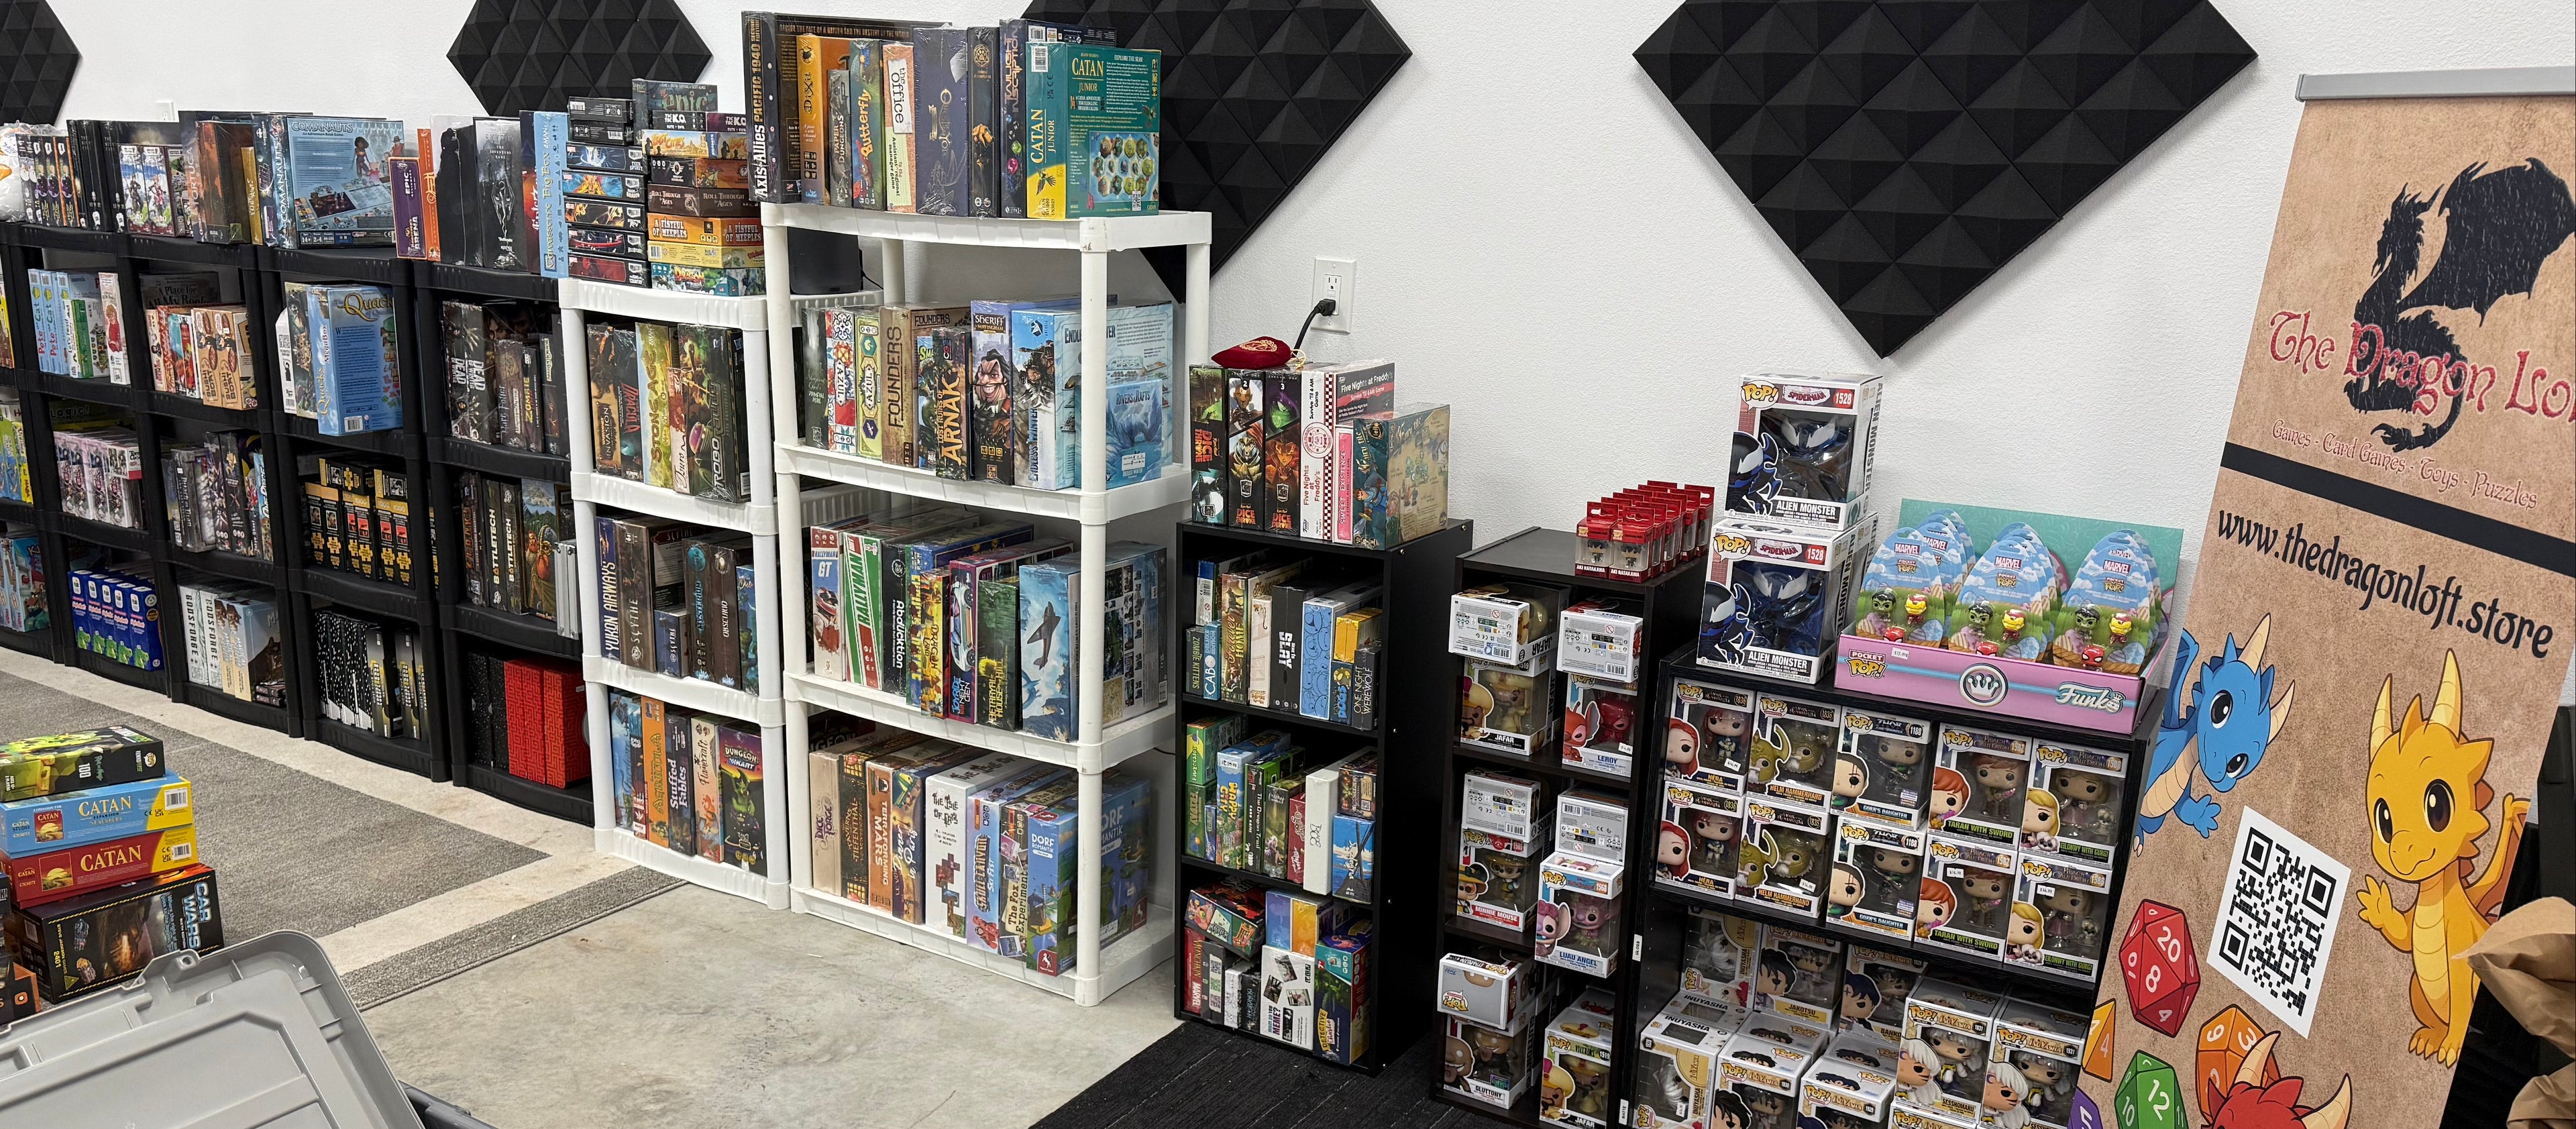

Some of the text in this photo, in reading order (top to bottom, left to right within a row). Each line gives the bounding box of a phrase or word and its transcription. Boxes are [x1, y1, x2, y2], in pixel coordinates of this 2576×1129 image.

[751, 44, 761, 72] 1940
[1071, 58, 1104, 76] CATAN
[751, 73, 763, 122] PACIFIC
[1078, 82, 1098, 93] JUNIOR
[291, 121, 354, 133] COMANAUTS
[859, 89, 873, 160] Butterfly
[1030, 109, 1045, 164] CATAN
[275, 140, 288, 229] COMANAUTS
[652, 227, 687, 238] OF MEEPLES
[726, 232, 761, 242] OF MEEPLES
[337, 292, 393, 321] Quack
[914, 313, 951, 325] FOUNDERS
[38, 330, 46, 354] Pete
[455, 358, 466, 384] DEAD
[473, 360, 486, 391] DEAD
[887, 326, 902, 428] FOUNDERS
[2269, 310, 2576, 424] The Dragon Lo
[202, 370, 211, 398] SUSHI
[208, 370, 217, 397] BOAT
[221, 372, 231, 399] SUSHI
[227, 373, 235, 399] BOAT
[318, 368, 331, 415] Quacks
[836, 363, 845, 402] AZUL
[1243, 380, 1248, 388] 2
[1280, 382, 1285, 390] 3
[1742, 383, 1778, 402] POP!
[524, 377, 534, 423] ZOMBIE
[621, 382, 641, 434] DRACULA
[643, 350, 663, 464] STONE AGE
[1835, 394, 1852, 405] 1528
[940, 375, 964, 466] ARNAK
[1028, 407, 1038, 482] ENDLESS WINTER
[1202, 431, 1213, 462] DICE
[1864, 382, 1883, 492] ALIEN MONSTER
[2272, 419, 2538, 511] Games Card Games Toys Puzzles
[1776, 500, 1836, 515] ALIEN MONSTER
[489, 508, 500, 584] BATTLETECH
[506, 519, 515, 582] BATTLETECH
[1713, 535, 1751, 554] POP!
[1807, 547, 1824, 561] 1528
[1845, 534, 1855, 572] ALIEN
[1894, 543, 1921, 555] MARVEL
[818, 561, 832, 578] GT
[1994, 556, 2022, 570] MARVEL
[2104, 559, 2131, 574] MARVEL
[849, 554, 870, 626] RALLYMAN
[2217, 510, 2555, 659] www.thedragonloft.store
[601, 561, 619, 651] YUKON AIRWAYS
[693, 581, 704, 631] MYSTERIUM
[185, 594, 199, 656] GODSFORGE
[205, 599, 218, 661] GODSFORGE
[631, 598, 642, 643] SCYTHE
[1235, 623, 1244, 657] HOME
[1279, 631, 1293, 669] SLAY
[1748, 652, 1807, 668] ALIEN MONSTER
[1848, 659, 1886, 678] POP!
[1851, 651, 1883, 661] POCKET
[952, 676, 960, 713] JOYRIDE
[987, 674, 998, 722] BETRAYAL
[1354, 665, 1363, 714] ONE NIGHT
[1363, 667, 1373, 714] WEREWOLF
[995, 690, 1004, 718] HOUSE
[1495, 735, 1514, 743] JAFAR
[695, 739, 710, 785] Flamecraft
[724, 747, 757, 761] DUNGEON
[737, 761, 755, 771] KART
[1597, 755, 1618, 764] LEROY
[78, 762, 91, 778] 100
[650, 733, 664, 814] AGRICOLA
[1708, 774, 1723, 783] HERA
[667, 759, 678, 809] Stuffed
[678, 766, 688, 808] Fables
[1770, 785, 1822, 801] HELM HAMMERHAND
[78, 796, 131, 817] CATAN
[932, 792, 958, 811] THE ISLE
[38, 812, 59, 821] CATAN
[814, 816, 824, 840] DICE
[824, 804, 837, 837] FORGE
[843, 808, 852, 849] TAVERNS
[1948, 820, 2013, 839] TARAN WITH SWORD
[873, 816, 883, 867] MARS
[892, 824, 906, 871] Dinner
[1031, 833, 1055, 846] DORF
[80, 845, 142, 872] CATAN
[17, 869, 36, 877] CATAN
[1542, 871, 1566, 885] POP!
[1699, 876, 1714, 885] HERA
[194, 881, 213, 922] CAR
[1008, 883, 1020, 928] The Fox
[1016, 871, 1028, 933] Experiment
[1475, 906, 1518, 922] MINNIE MOUSE
[182, 894, 201, 949] WARS
[1934, 929, 1998, 950] TARAN WITH SWORD
[2156, 925, 2182, 963] 20
[53, 950, 61, 968] 2401
[1560, 951, 1598, 966] LUAU ANGEL
[1191, 940, 1201, 1007] MUNCHKIN MARVEL
[2145, 965, 2161, 993] 8
[1684, 995, 1728, 1010] INUYASHA
[1788, 1004, 1816, 1016] JAKOTSU
[1273, 1008, 1281, 1035] MEME?
[1319, 1010, 1328, 1049] DETECTIVE
[1664, 1015, 1710, 1032] INUYASHA
[1548, 1036, 1571, 1051] POP!
[1599, 1051, 1610, 1060] 1519
[1475, 1085, 1502, 1098] GLUTTONY
[2147, 1079, 2170, 1122] 12
[1575, 1117, 1595, 1127] JAFAR
